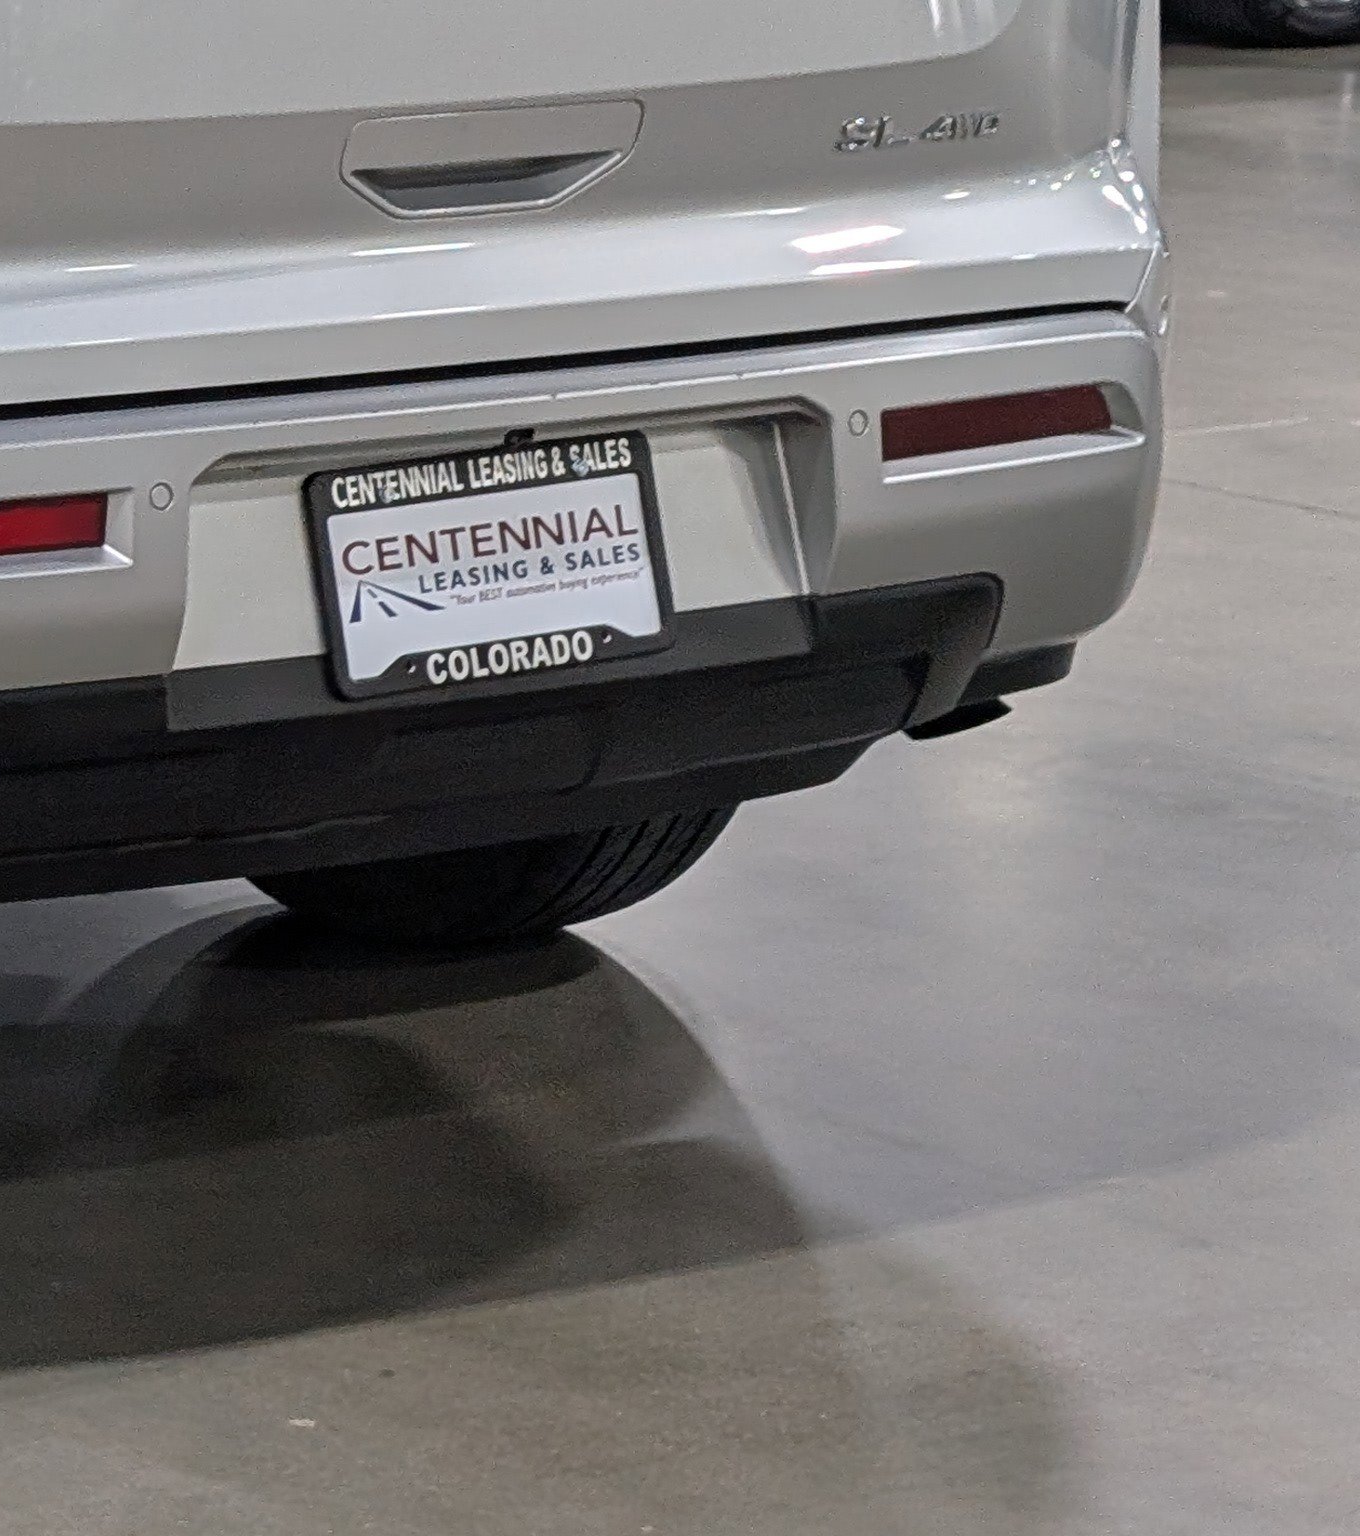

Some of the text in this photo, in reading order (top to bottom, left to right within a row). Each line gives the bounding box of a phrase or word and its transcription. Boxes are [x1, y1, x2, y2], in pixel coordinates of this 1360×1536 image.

[833, 111, 911, 152] SL
[331, 437, 631, 509] CENTENNIAL LEASING & SALES
[342, 504, 639, 575] CENTENNIAL
[418, 543, 640, 594] LEASING & SALES
[426, 630, 594, 685] COLORADO
